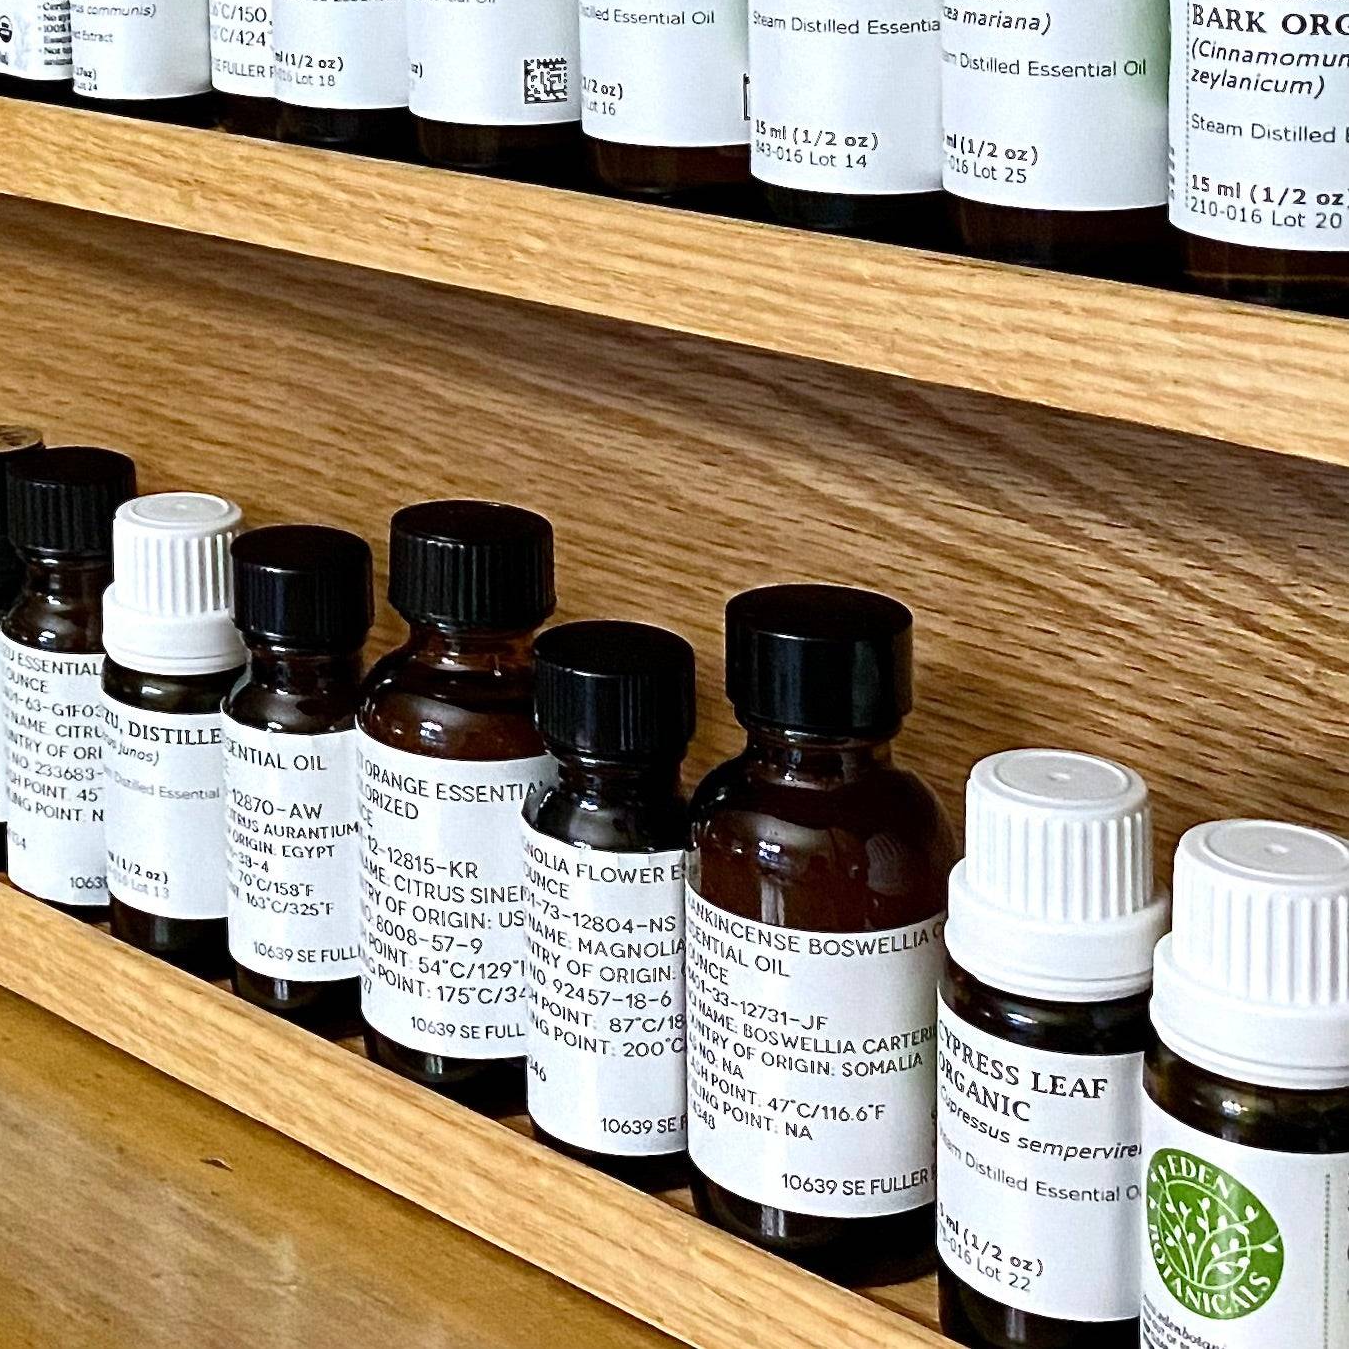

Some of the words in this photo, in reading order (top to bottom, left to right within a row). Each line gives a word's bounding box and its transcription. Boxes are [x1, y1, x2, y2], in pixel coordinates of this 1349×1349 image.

[87, 5, 156, 17] communis)
[614, 10, 685, 25] Essential
[692, 12, 714, 25] Oil
[753, 10, 785, 30] Steam
[791, 17, 859, 34] Distilled
[868, 18, 940, 35] Essentia
[963, 11, 1051, 35] mariana)
[1193, 4, 1266, 33] BARK
[222, 62, 271, 78] FULLER
[285, 53, 313, 68] (1/2
[318, 57, 344, 71] oz)
[961, 53, 1020, 75] Distilled
[1028, 61, 1117, 77] Essential
[1124, 59, 1147, 76] Oil
[295, 74, 314, 85] Lot
[320, 75, 335, 86] 18
[601, 82, 623, 100] oz)
[1191, 68, 1325, 99] zeylanicum)
[602, 102, 615, 115] 16
[756, 120, 767, 134] 15
[770, 125, 787, 140] ml
[793, 127, 837, 147] (1/2
[845, 132, 878, 150] oz)
[1192, 114, 1242, 137] Steam
[1252, 123, 1335, 143] Distilled
[810, 152, 836, 167] Lot
[846, 155, 867, 168] 14
[961, 137, 997, 159] (1/2
[1005, 146, 1038, 165] oz)
[973, 165, 997, 181] Lot
[1005, 169, 1027, 183] 25
[1192, 175, 1210, 192] 15
[1218, 181, 1240, 199] ml
[1250, 185, 1306, 205] (1/2
[1191, 196, 1262, 223] 210-016
[1272, 210, 1305, 227] Lot
[1315, 212, 1342, 228] 20
[18, 653, 99, 676] ESSENTIAL
[129, 721, 221, 745] DISTILLE
[47, 744, 69, 758] OF
[118, 743, 159, 766] junos)
[294, 755, 327, 772] OIL
[365, 759, 429, 797] ORANGE
[159, 786, 219, 800] Essential
[264, 822, 359, 839] AURANTIUM
[282, 845, 335, 858] EGYPT
[146, 869, 169, 884] oz)
[577, 863, 664, 883] FLOWER
[394, 875, 464, 903] CITRUS
[386, 891, 406, 915] OF
[413, 906, 492, 930] ORIGIN:
[376, 914, 482, 954] 8008-57-9
[809, 929, 929, 957] BOSWELLIA
[254, 942, 293, 962] 10639
[298, 950, 315, 962] SE
[578, 938, 686, 958] MAGNOLIA
[567, 960, 591, 979] OF
[600, 966, 676, 984] ORIGIN:
[755, 955, 790, 977] OIL
[553, 979, 671, 1010] 92457-18-6
[411, 1016, 456, 1038] 10639
[461, 1025, 480, 1039] SE
[486, 1023, 524, 1038] FULL
[743, 1022, 855, 1055] BOSWELLIA
[723, 1059, 743, 1079] NA
[734, 1042, 755, 1060] OF
[761, 1051, 835, 1077] ORIGIN:
[842, 1052, 922, 1077] SOMALIA
[1031, 1071, 1108, 1099] LEAF
[602, 1117, 653, 1134] 10639
[656, 1118, 676, 1132] SE
[723, 1101, 778, 1134] POINT:
[785, 1123, 813, 1140] NA
[782, 1173, 838, 1195] 10639
[842, 1180, 866, 1195] SE
[870, 1168, 927, 1194] FULLER
[965, 1151, 1028, 1192] Distilled
[1036, 1181, 1120, 1202] Essential
[1166, 1154, 1236, 1199] EDEN
[963, 1227, 1002, 1262] (1/2
[1010, 1255, 1043, 1277] oz)
[976, 1258, 1002, 1282] Lot
[1008, 1272, 1031, 1292] 22
